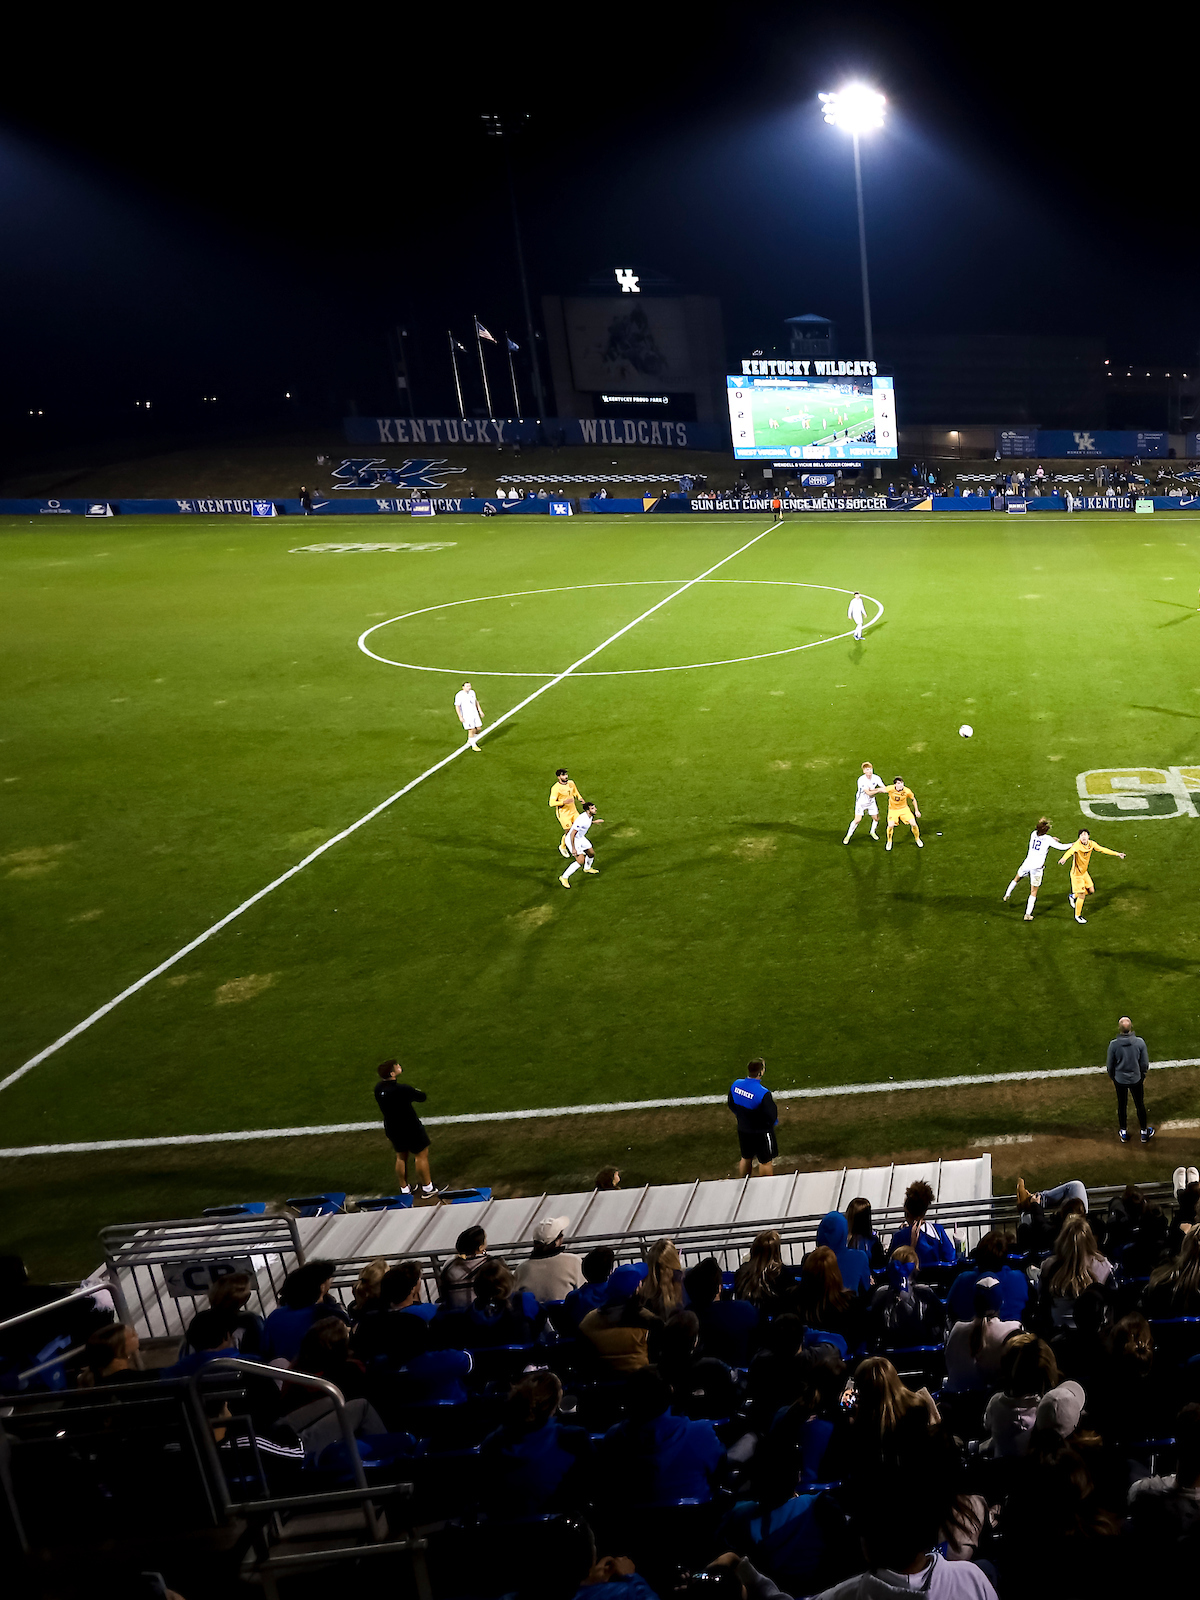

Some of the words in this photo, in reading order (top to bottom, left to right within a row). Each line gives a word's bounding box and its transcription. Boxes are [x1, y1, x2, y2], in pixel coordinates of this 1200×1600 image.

[614, 268, 641, 293] UK
[742, 360, 811, 376] KENTUCKY
[814, 361, 878, 376] WILDCATS
[376, 419, 506, 443] KENTUCKY
[579, 418, 688, 447] WILDCATS
[1072, 432, 1095, 450] UK
[789, 446, 801, 458] 0
[835, 446, 846, 458] 1
[849, 447, 892, 456] KENTUCKY
[808, 475, 828, 486] SBC
[553, 503, 567, 515] UK
[691, 499, 714, 510] SUN
[716, 499, 741, 510] BELT
[812, 498, 845, 510] MEN'S
[846, 498, 888, 510] SOCCER
[1031, 838, 1043, 851] 12
[734, 1086, 755, 1100] KENTUCKY
